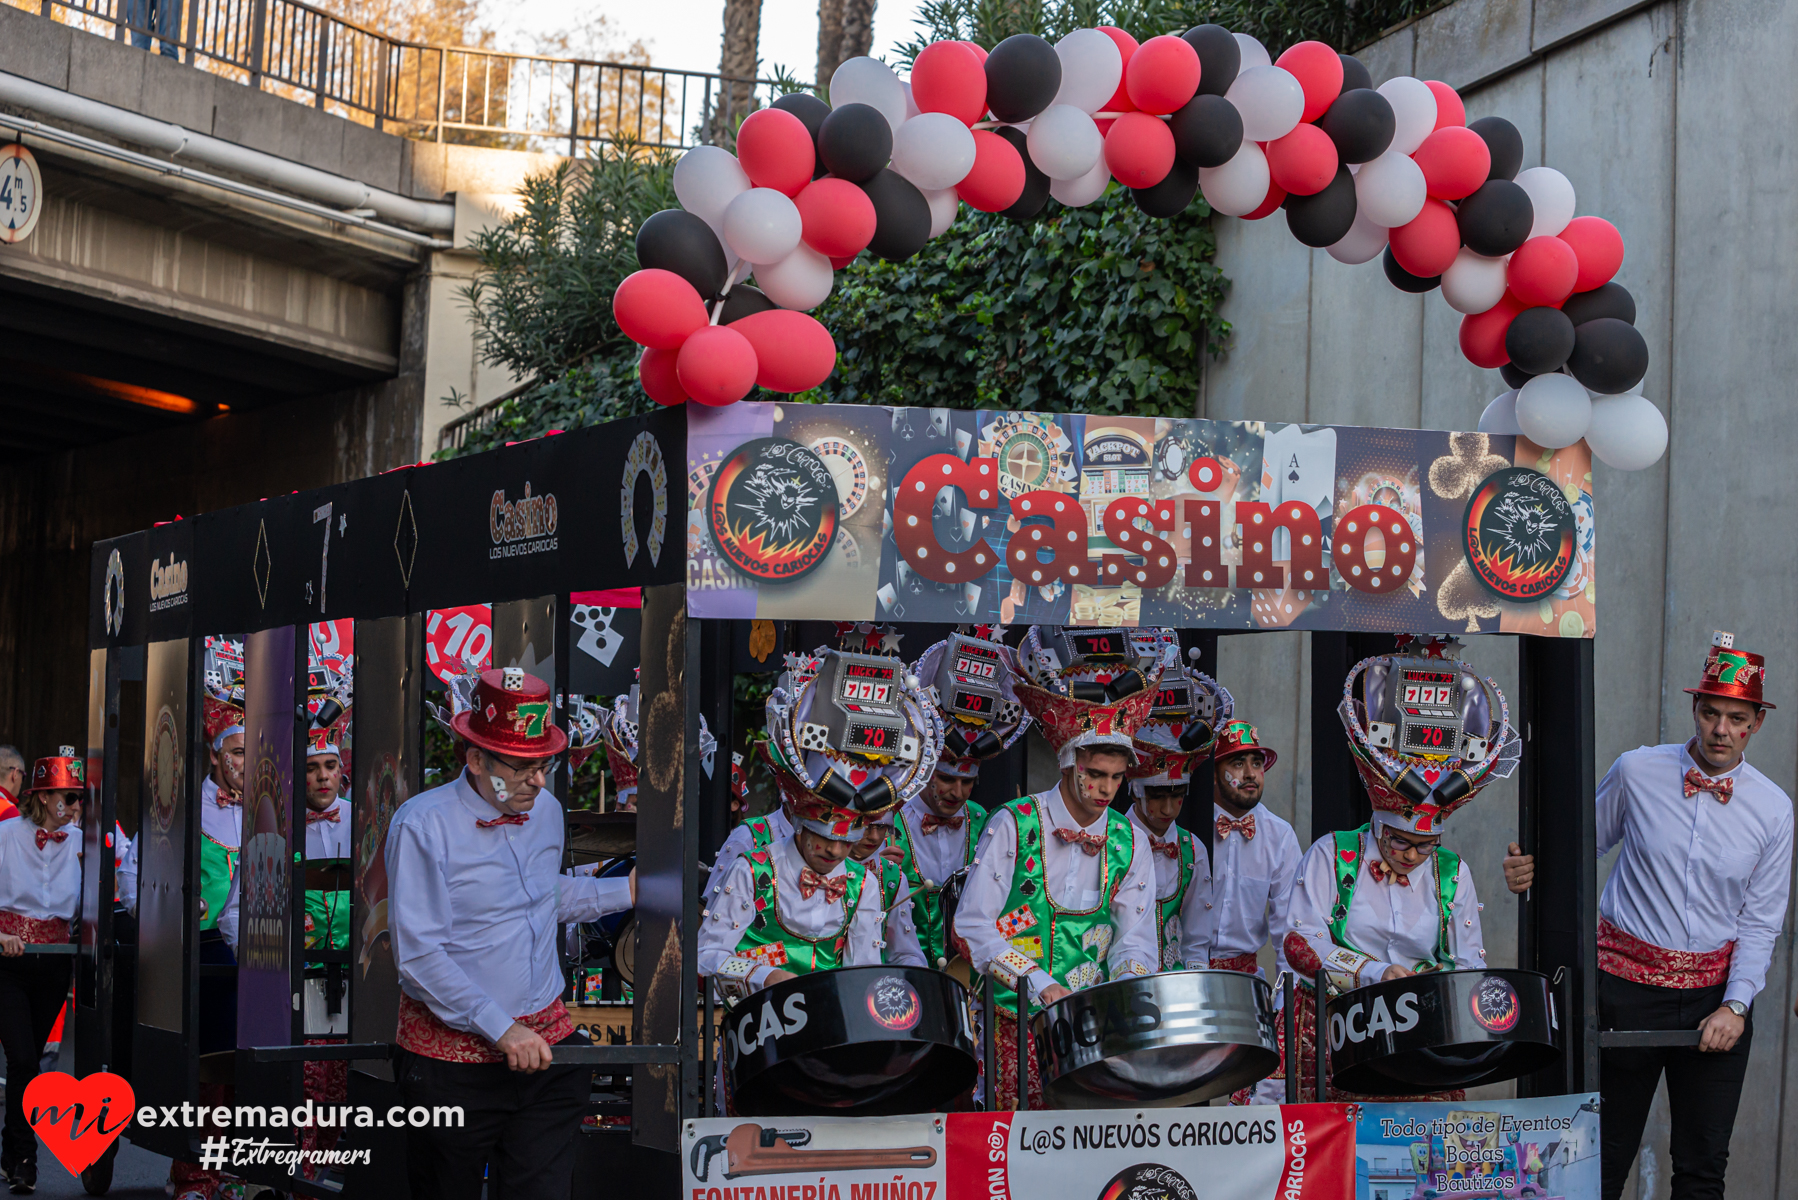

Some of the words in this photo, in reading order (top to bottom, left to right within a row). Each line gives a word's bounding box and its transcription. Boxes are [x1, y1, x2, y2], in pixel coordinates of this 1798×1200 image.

[1086, 440, 1141, 462] JACKPOT
[1103, 453, 1122, 462] SLOT
[1288, 453, 1300, 468] A
[1000, 474, 1042, 493] CASIN
[490, 481, 558, 544] Casino
[893, 453, 1417, 595] Casino
[490, 547, 502, 559] LOS
[502, 543, 527, 557] NUEVOS
[527, 537, 558, 554] CARIOCAS
[713, 503, 729, 537] L@S
[722, 537, 770, 575] NUEVOS
[773, 532, 828, 576] CARIOCAS
[1469, 527, 1481, 558] L@S
[1477, 560, 1518, 594] NUEVOS
[1520, 556, 1567, 596] CARIOCAS
[150, 551, 188, 601] Casino
[960, 644, 985, 656] LUCKY
[1087, 637, 1111, 653] 70
[849, 665, 878, 679] LUCKY
[1407, 671, 1438, 682] LUCKY
[1717, 651, 1750, 685] 7
[965, 694, 982, 711] 70
[515, 699, 550, 739] 7
[1088, 706, 1119, 736] 7
[308, 728, 331, 750] 7
[863, 727, 885, 747] 70
[1228, 722, 1255, 745] 7
[1422, 727, 1443, 747] 70
[1165, 754, 1191, 780] 7
[831, 805, 864, 838] 7
[1412, 803, 1443, 832] 7
[247, 917, 283, 971] CASINO
[1020, 1125, 1066, 1155] L@S
[1073, 1123, 1160, 1149] NUEVOS
[1167, 1119, 1277, 1146] CARIOCAS
[1380, 1118, 1427, 1137] Todo
[1431, 1118, 1471, 1139] tipo
[1472, 1116, 1495, 1134] de
[1500, 1115, 1572, 1132] Eventos
[987, 1121, 1010, 1163] L@S
[1445, 1145, 1504, 1163] Bodas
[1436, 1173, 1514, 1193] Bautizos
